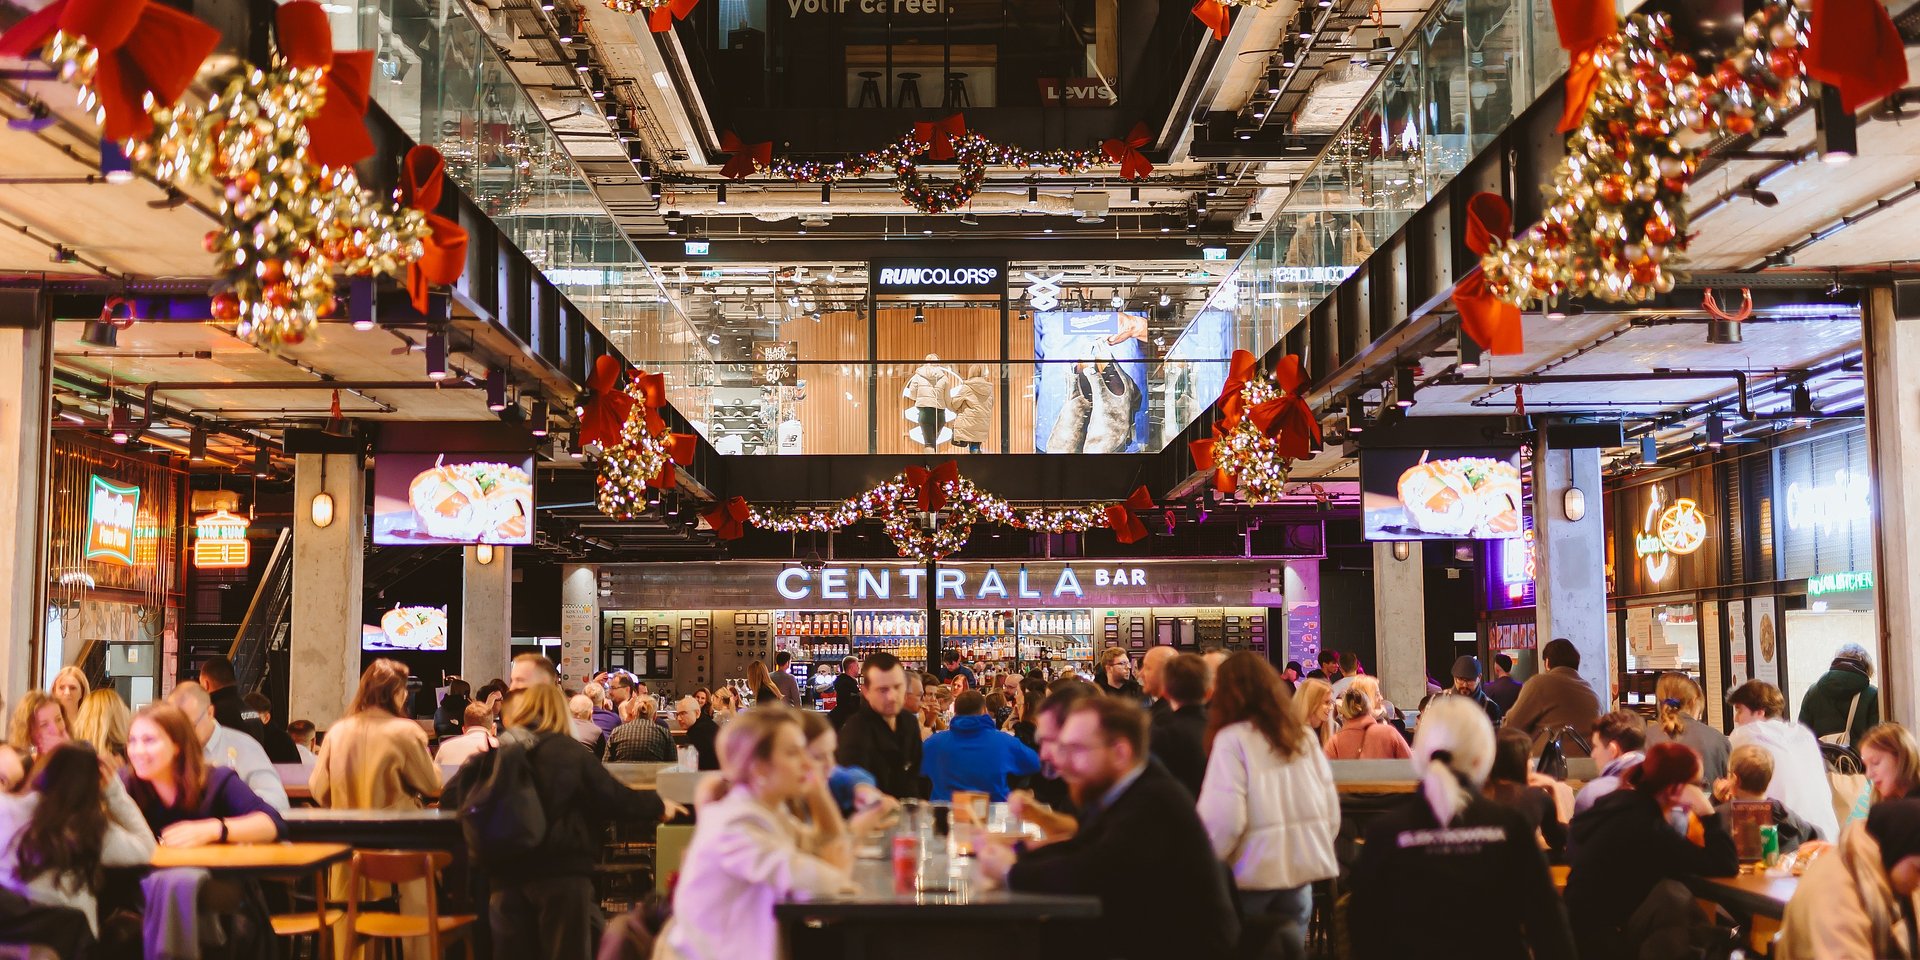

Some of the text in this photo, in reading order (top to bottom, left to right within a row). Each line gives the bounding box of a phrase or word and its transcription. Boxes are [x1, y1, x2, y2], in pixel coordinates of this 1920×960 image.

[880, 268, 990, 285] RUNCOLORS
[764, 346, 787, 355] BLACK
[765, 367, 790, 381] 60%
[776, 567, 1147, 600] CENTRALA BAR
